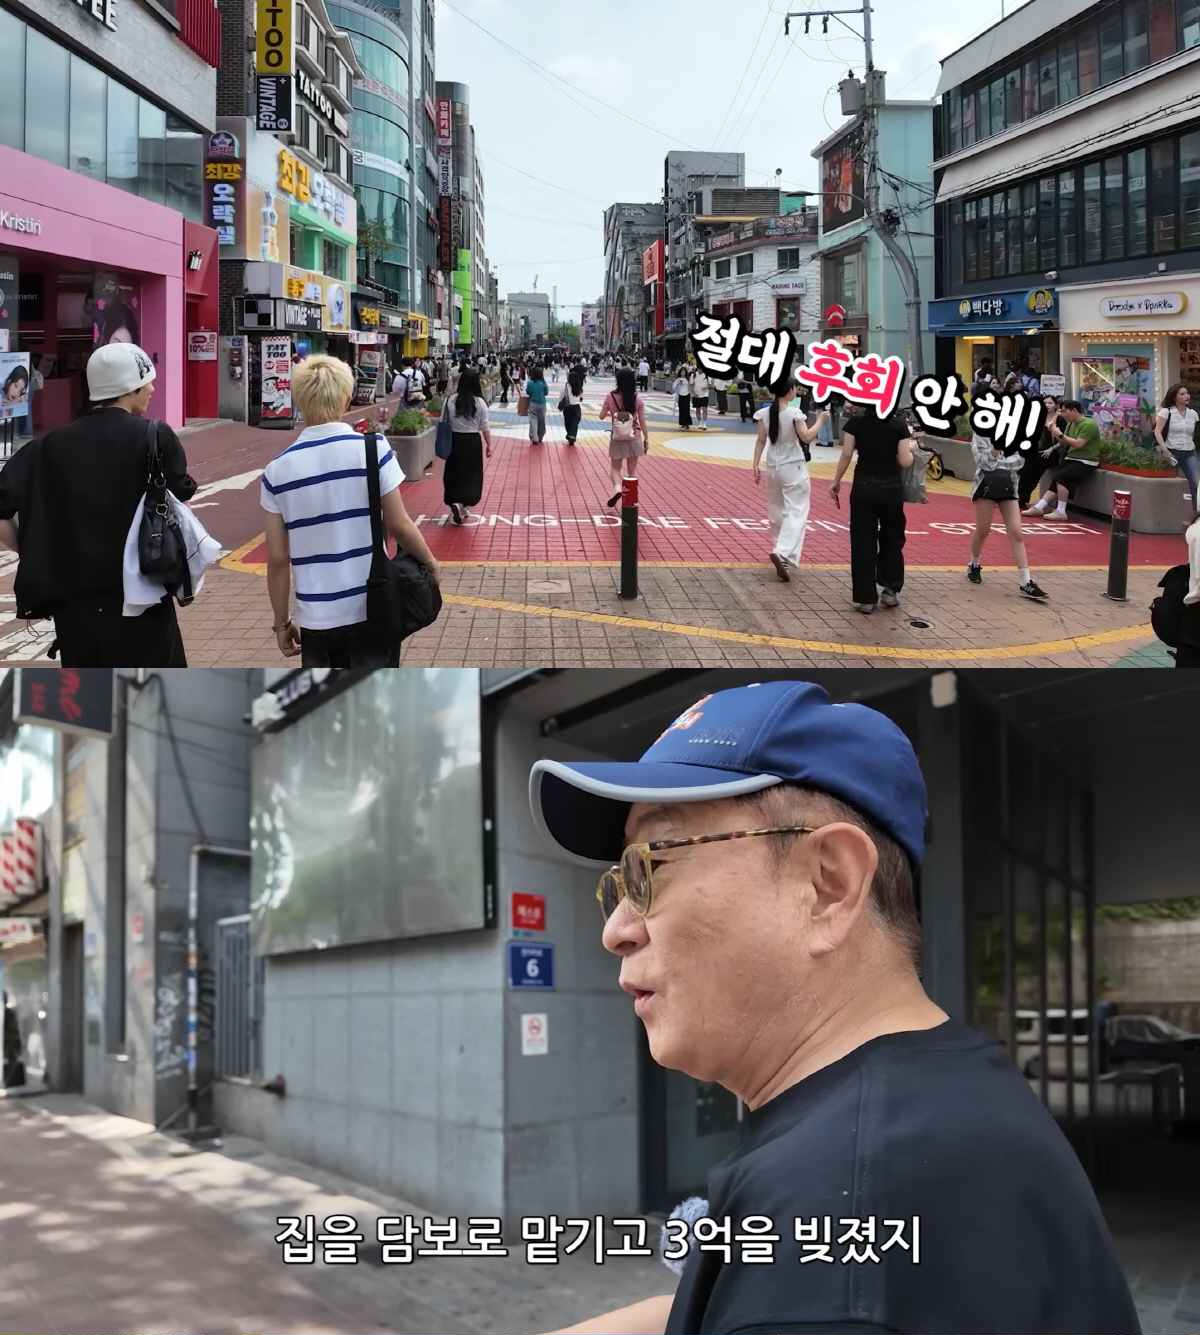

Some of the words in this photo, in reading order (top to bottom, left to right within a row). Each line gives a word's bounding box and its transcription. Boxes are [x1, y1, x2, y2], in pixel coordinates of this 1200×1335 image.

[259, 77, 277, 129] VINTAGE
[299, 70, 332, 119] TATTOO
[205, 163, 242, 180] 최강
[278, 149, 311, 203] 최강
[285, 304, 307, 326] VINTAGE
[526, 958, 540, 978] 6
